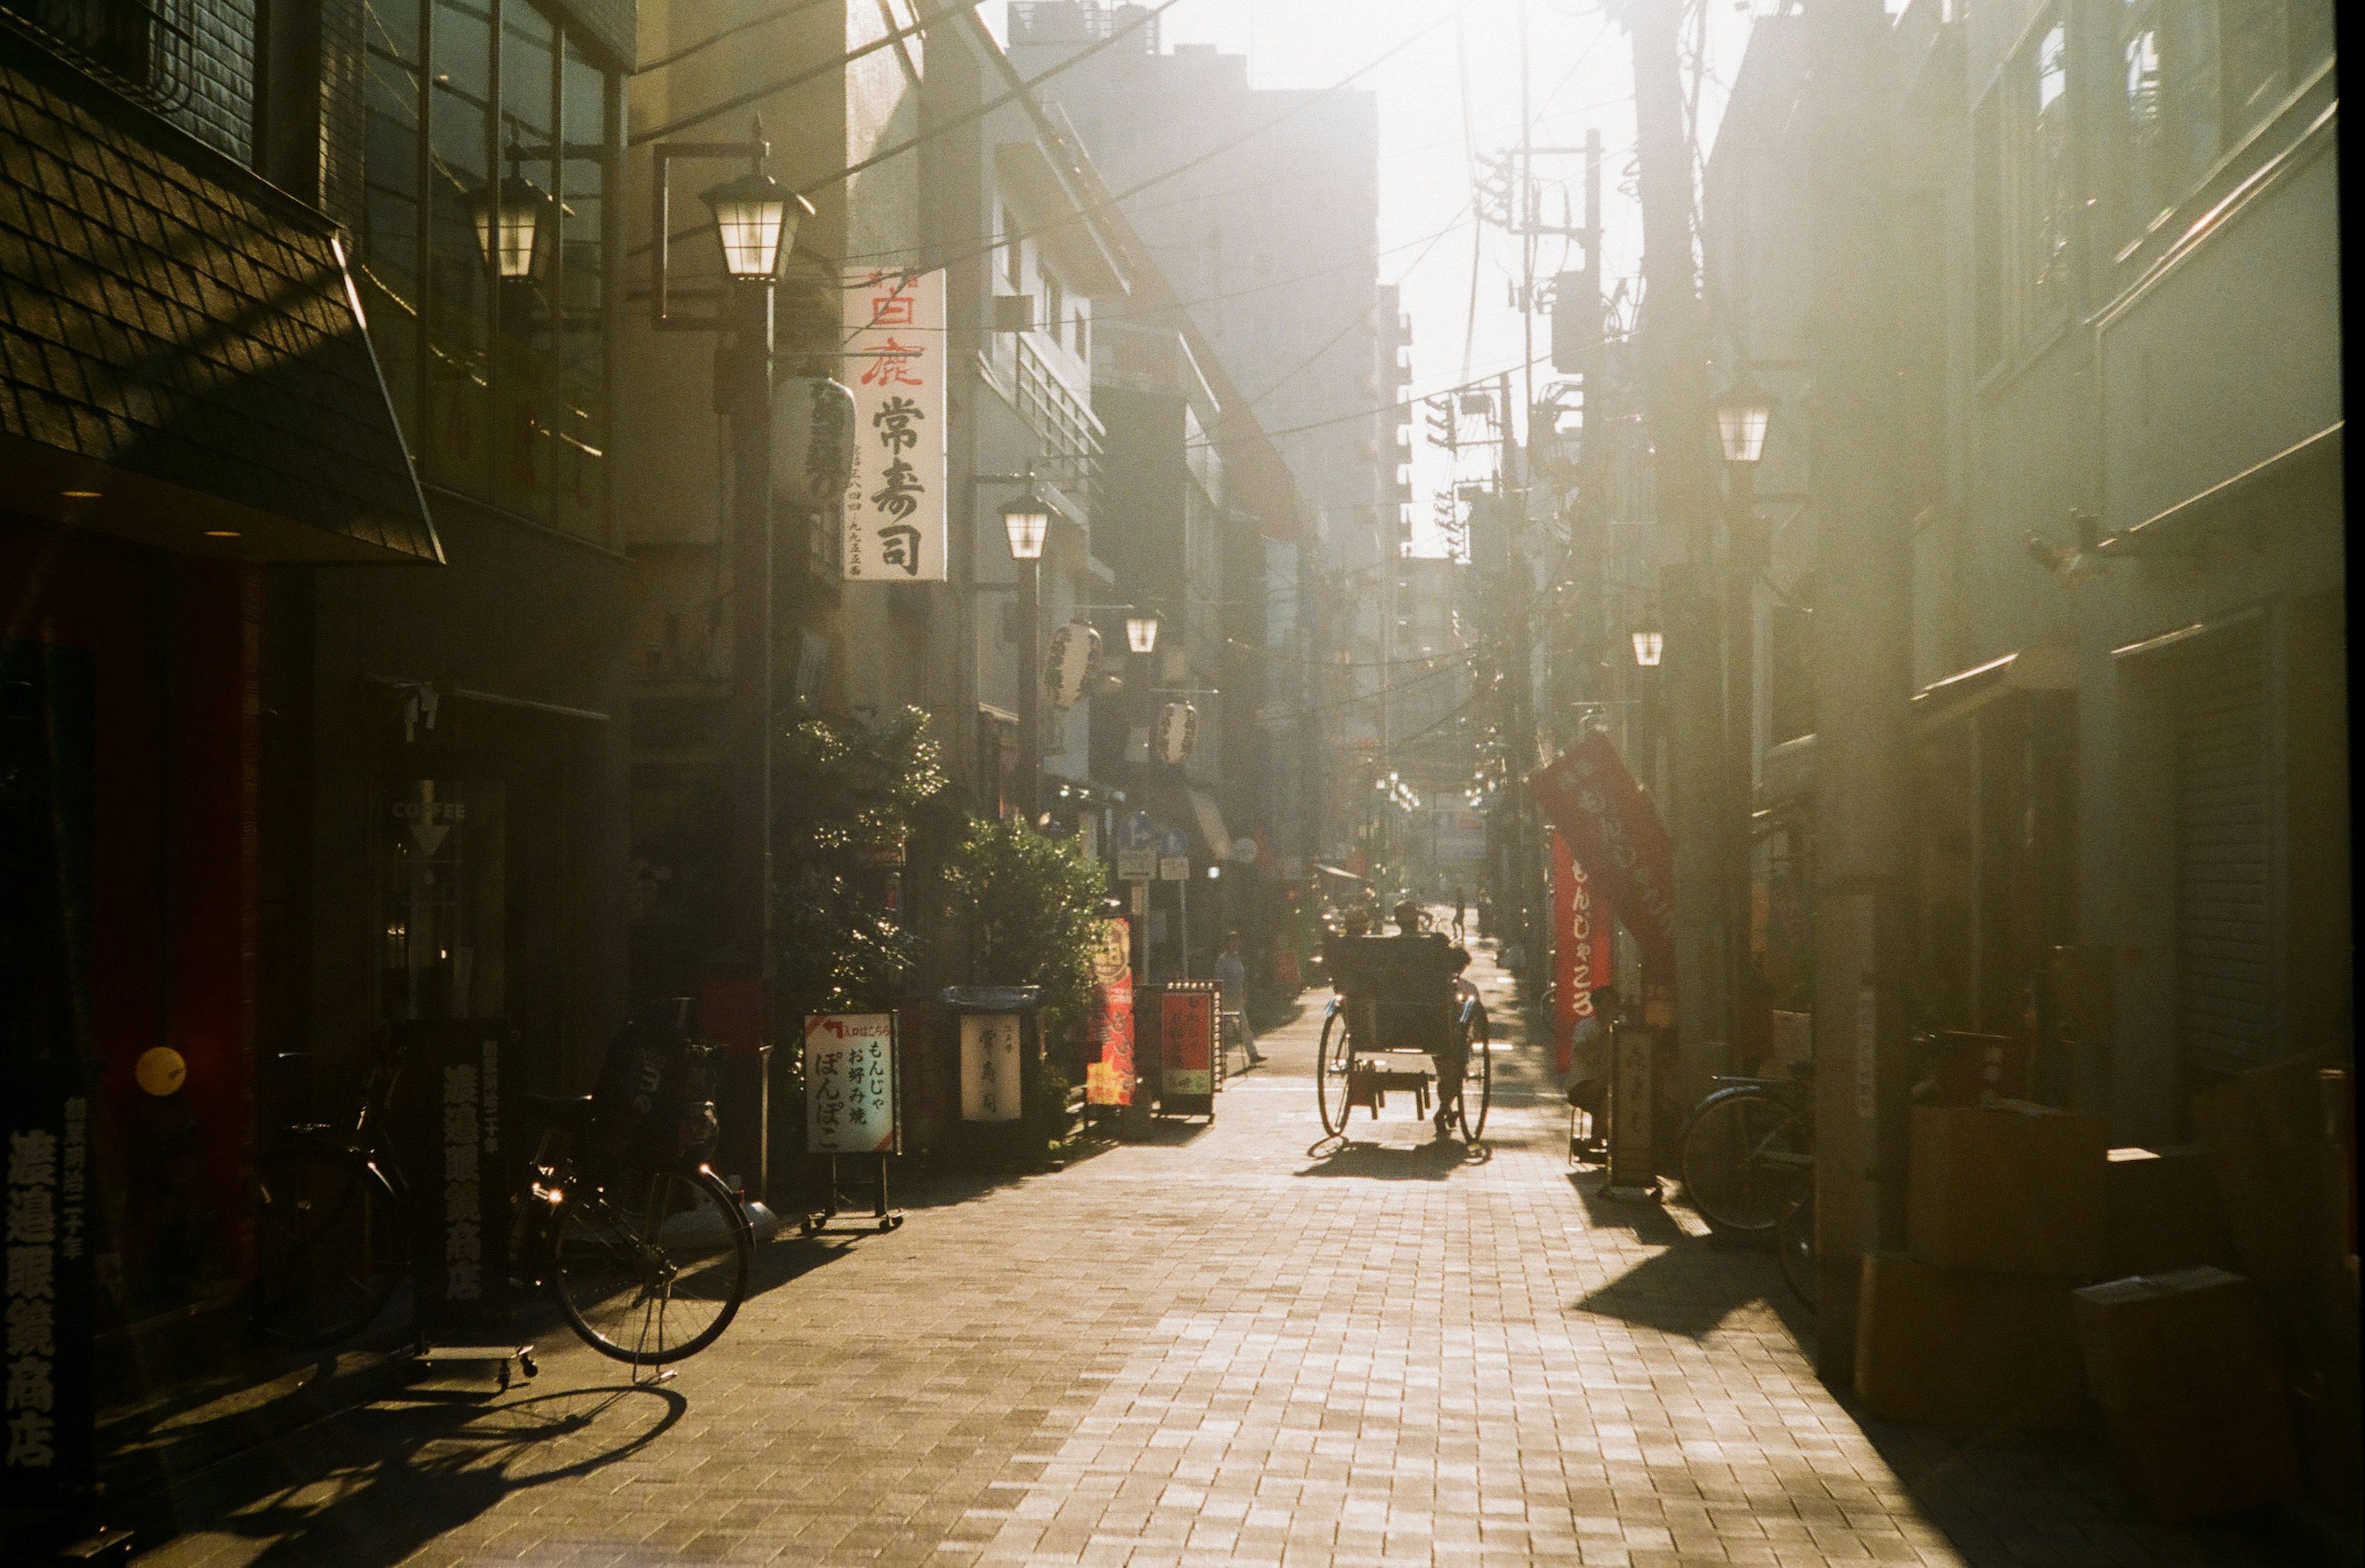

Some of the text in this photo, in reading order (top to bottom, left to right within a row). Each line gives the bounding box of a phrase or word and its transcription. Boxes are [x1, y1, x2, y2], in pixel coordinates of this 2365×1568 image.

[862, 287, 924, 386] 白鹿
[871, 396, 924, 576] 常寿司
[392, 802, 466, 819] COFEE
[1572, 860, 1595, 1016] もんじゃころ
[815, 1051, 844, 1150] ぽんぽこ
[868, 1041, 885, 1110] もんじゃ
